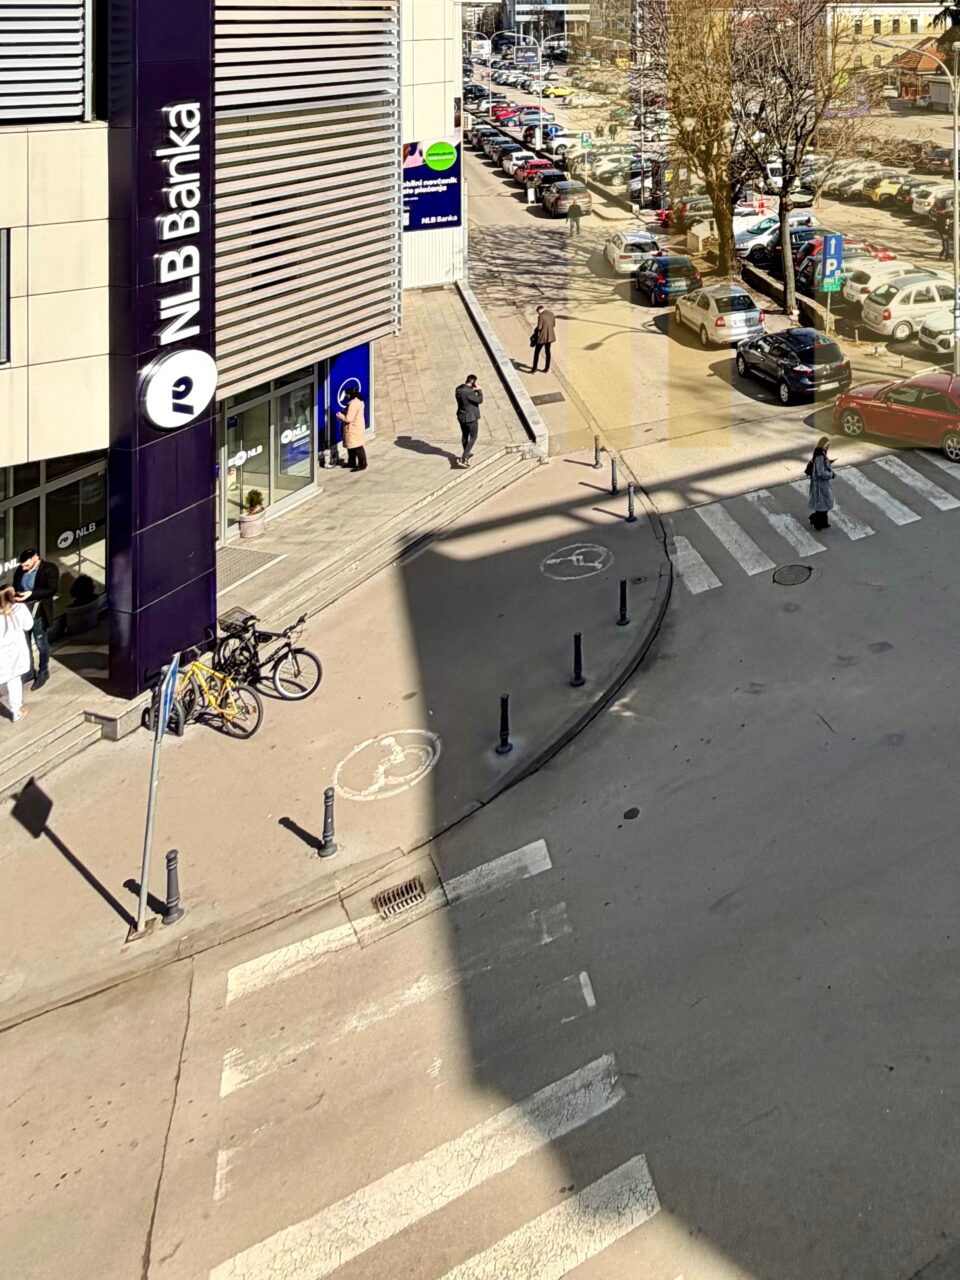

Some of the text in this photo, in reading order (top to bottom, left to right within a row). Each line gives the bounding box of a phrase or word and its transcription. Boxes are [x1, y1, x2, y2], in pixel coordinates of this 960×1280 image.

[423, 177, 457, 185] novčanik
[154, 101, 201, 346] NLB Banka
[437, 215, 458, 223] Banka
[825, 258, 838, 276] P
[292, 424, 307, 437] NLB
[247, 445, 263, 459] NLB
[75, 522, 96, 539] NLB
[4, 557, 20, 572] NL
